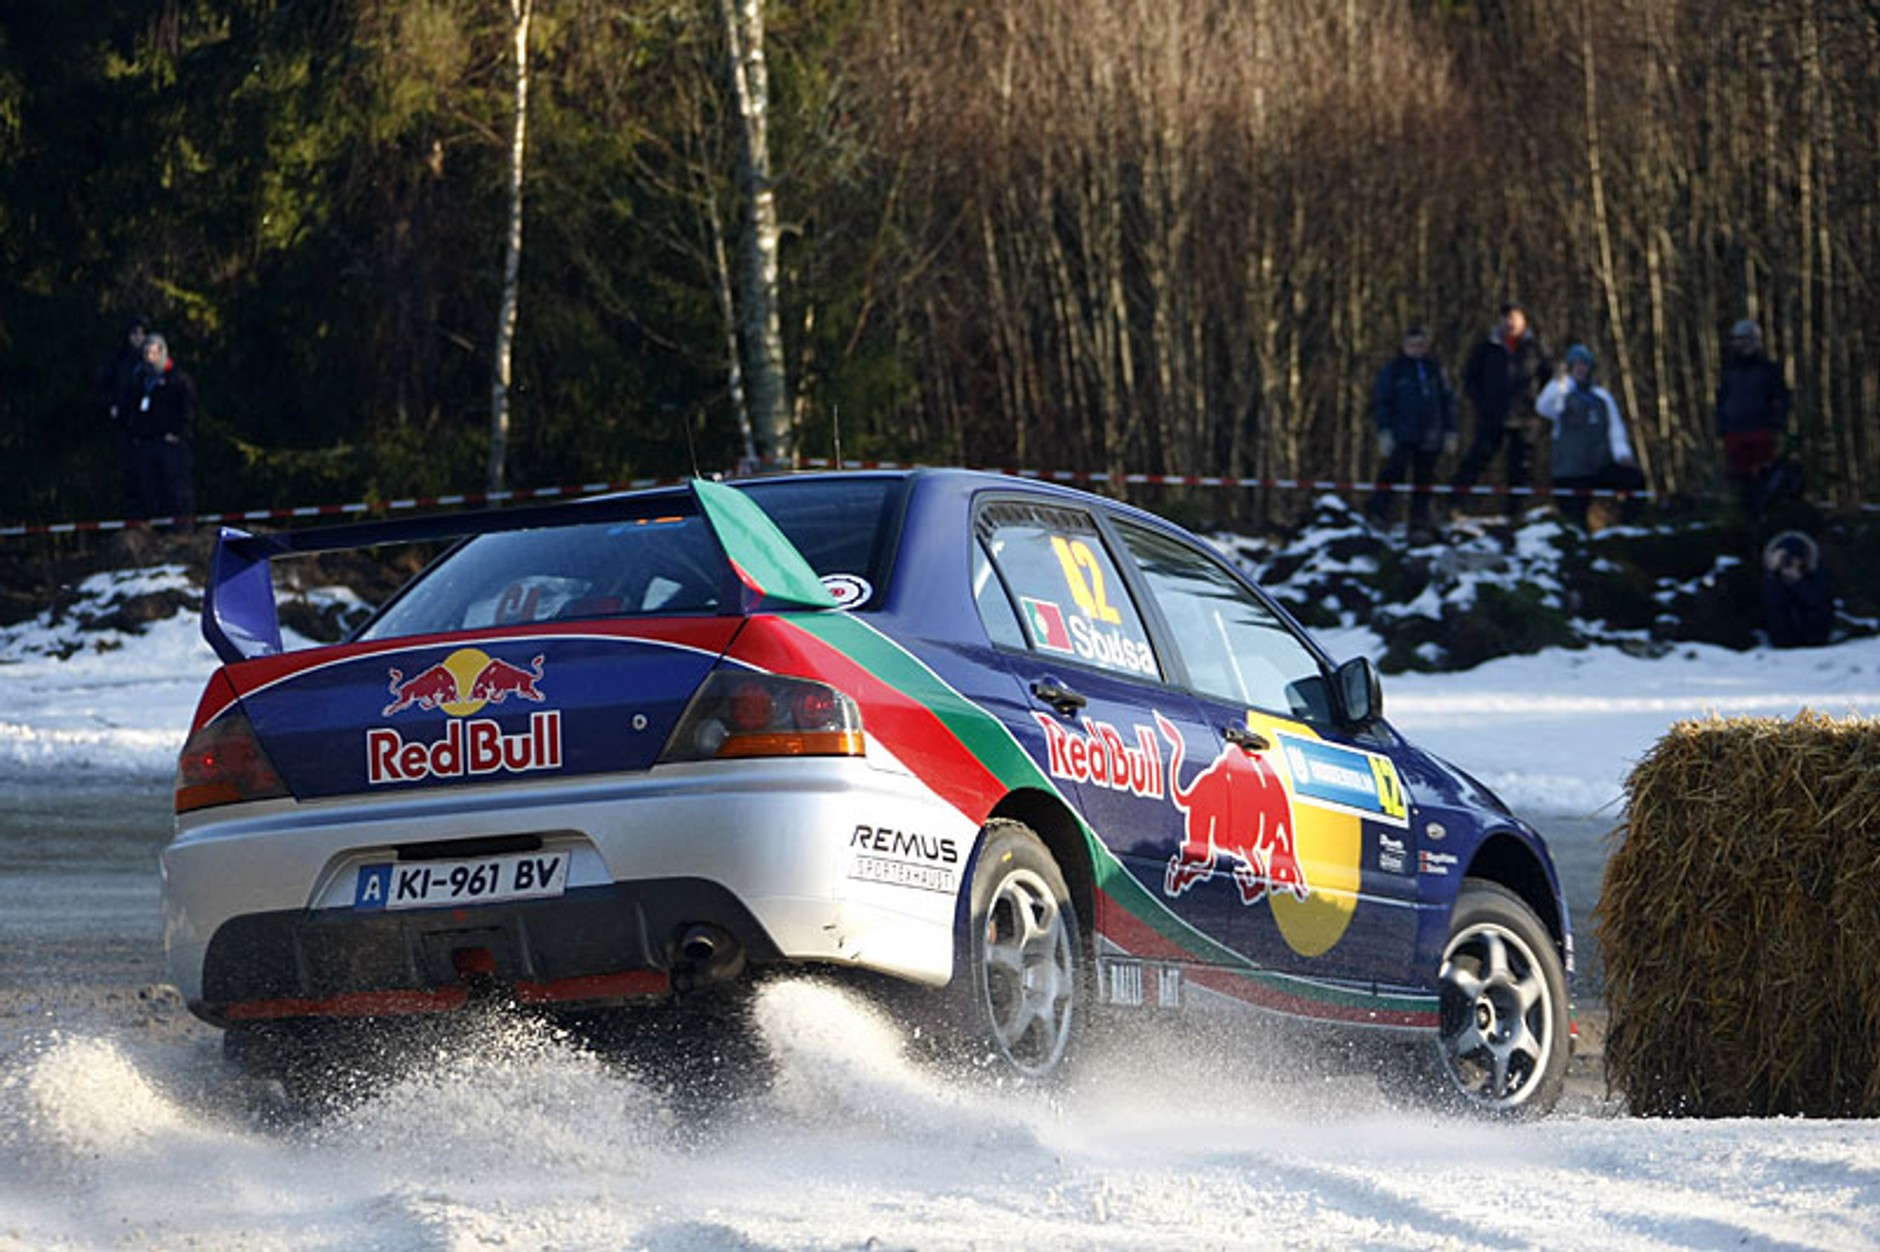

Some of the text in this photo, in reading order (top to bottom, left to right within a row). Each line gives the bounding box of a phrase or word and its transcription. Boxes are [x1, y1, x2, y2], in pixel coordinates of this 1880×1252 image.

[850, 825, 958, 863] REMUS
[363, 857, 560, 901] A KI-961 BV
